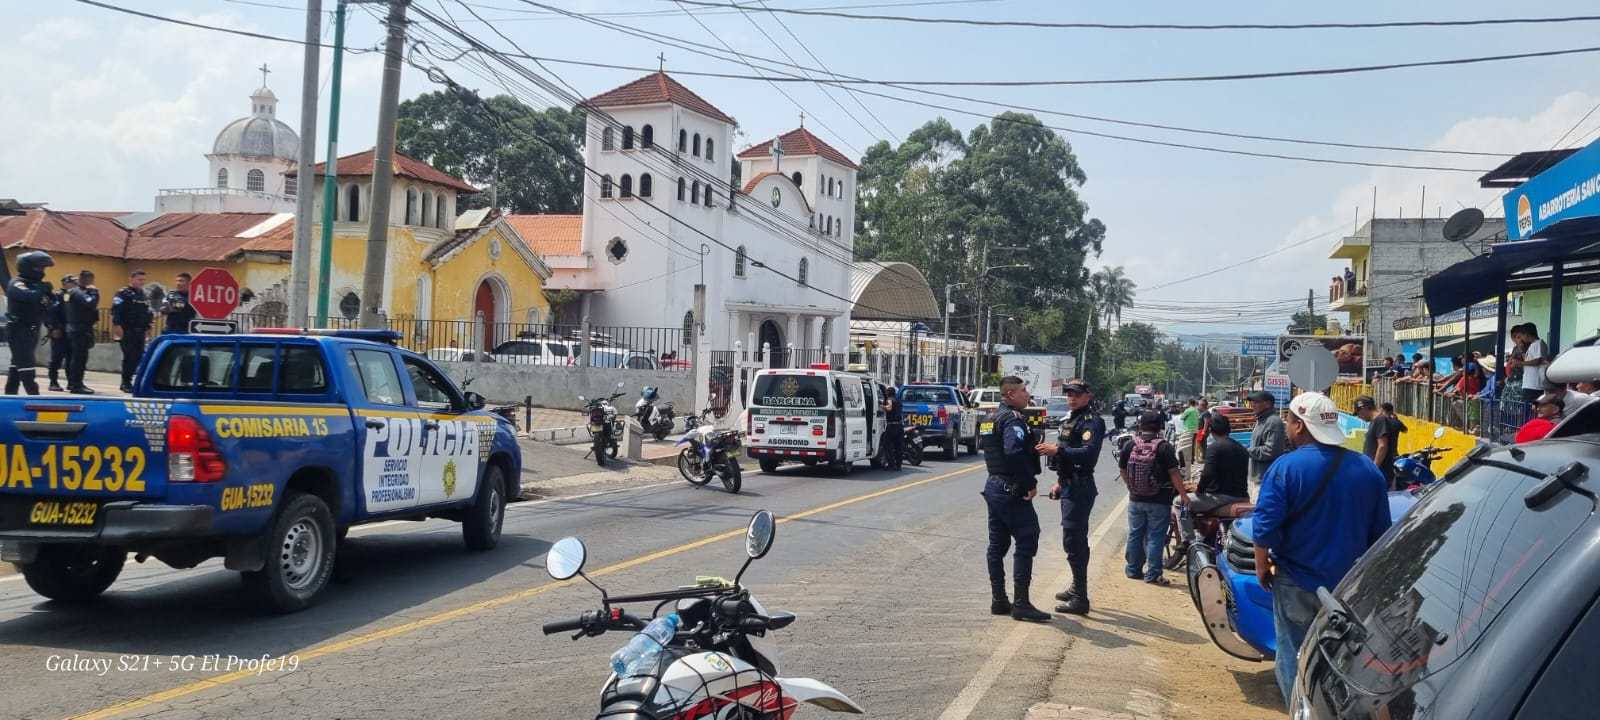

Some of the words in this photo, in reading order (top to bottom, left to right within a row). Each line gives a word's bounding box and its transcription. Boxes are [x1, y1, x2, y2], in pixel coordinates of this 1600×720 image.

[194, 284, 236, 304] ALTO
[762, 396, 817, 407] BARCENA
[216, 417, 310, 438] COMISARIA
[312, 417, 328, 436] 15
[364, 416, 478, 457] POLICIA
[767, 438, 809, 447] ASONBOMD
[383, 459, 408, 472] SERVICIO
[378, 473, 409, 487] INTEGRIDAD
[222, 483, 274, 511] GUA-15232
[371, 487, 415, 503] PROFESIONALISMO
[30, 501, 97, 525] GUA-15232
